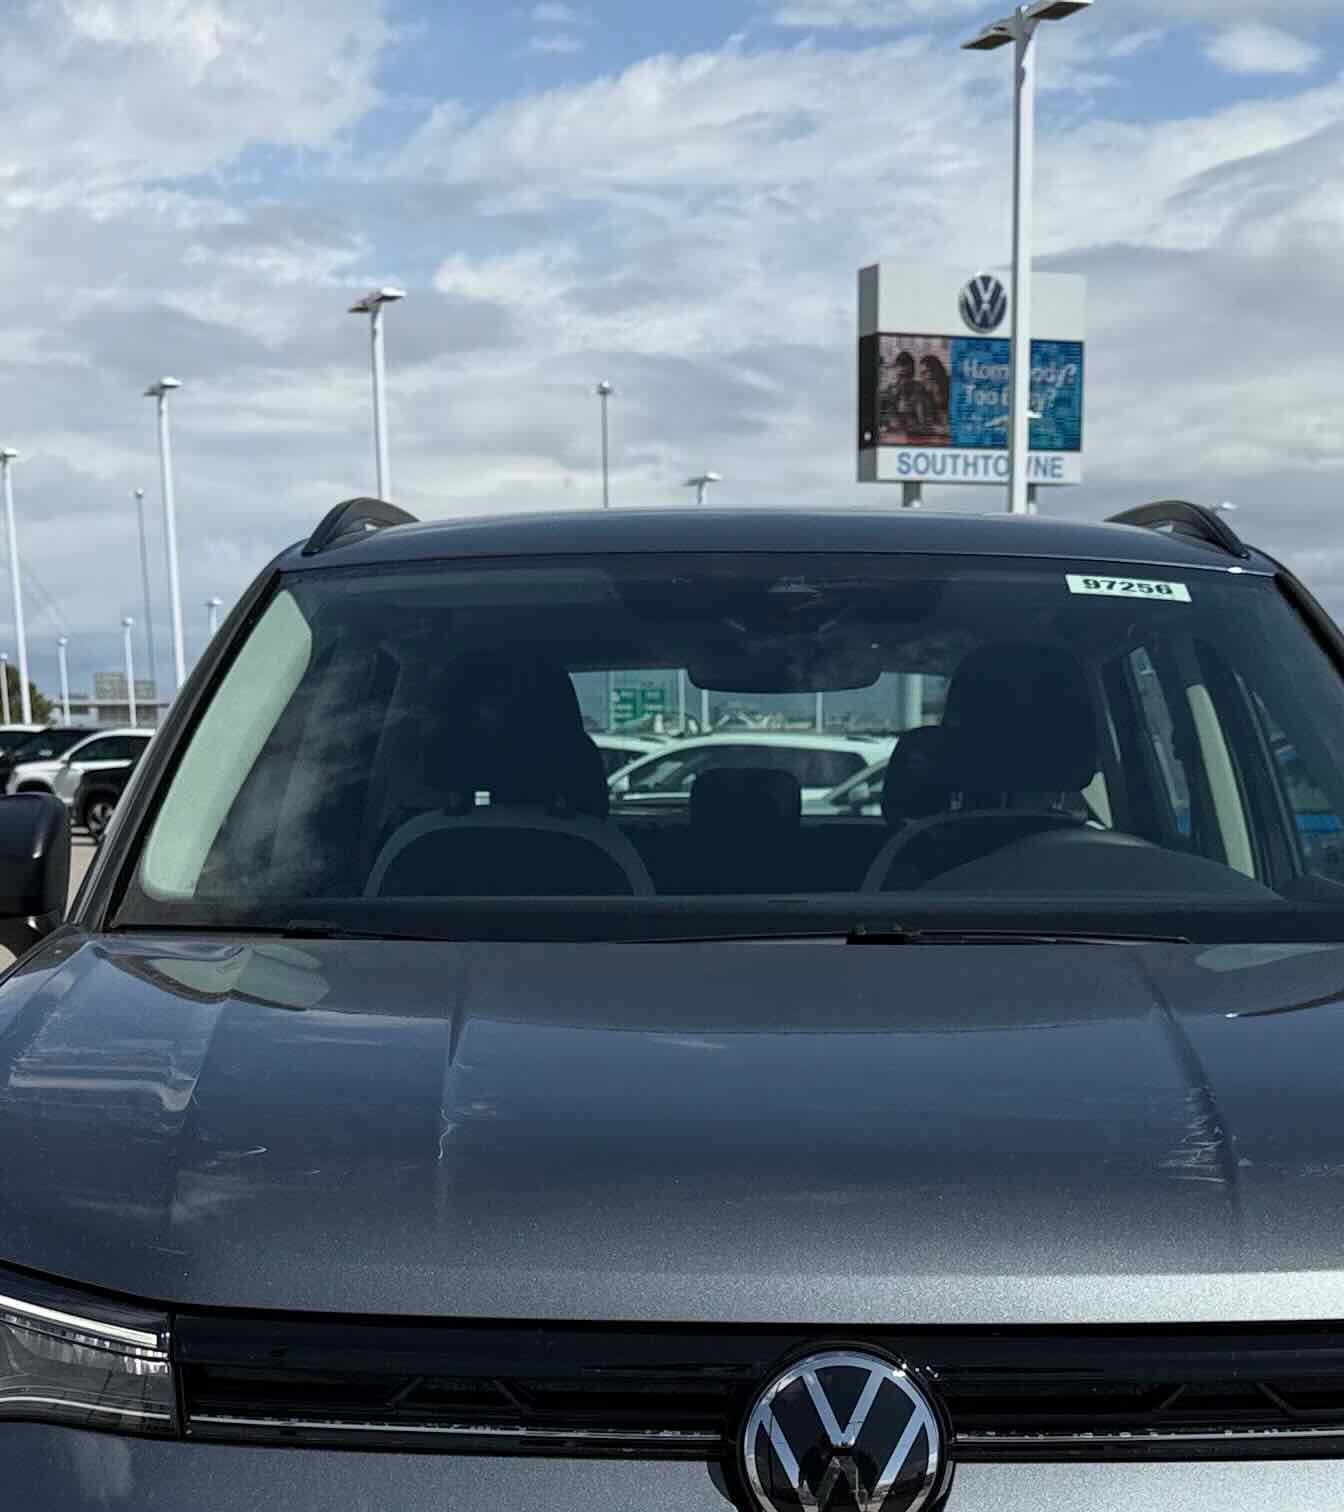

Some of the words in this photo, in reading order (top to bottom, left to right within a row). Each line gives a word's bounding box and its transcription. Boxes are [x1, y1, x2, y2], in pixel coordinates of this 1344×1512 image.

[963, 385, 999, 407] Too
[897, 451, 1064, 479] SOUTHTONE
[1082, 578, 1173, 595] 97256
